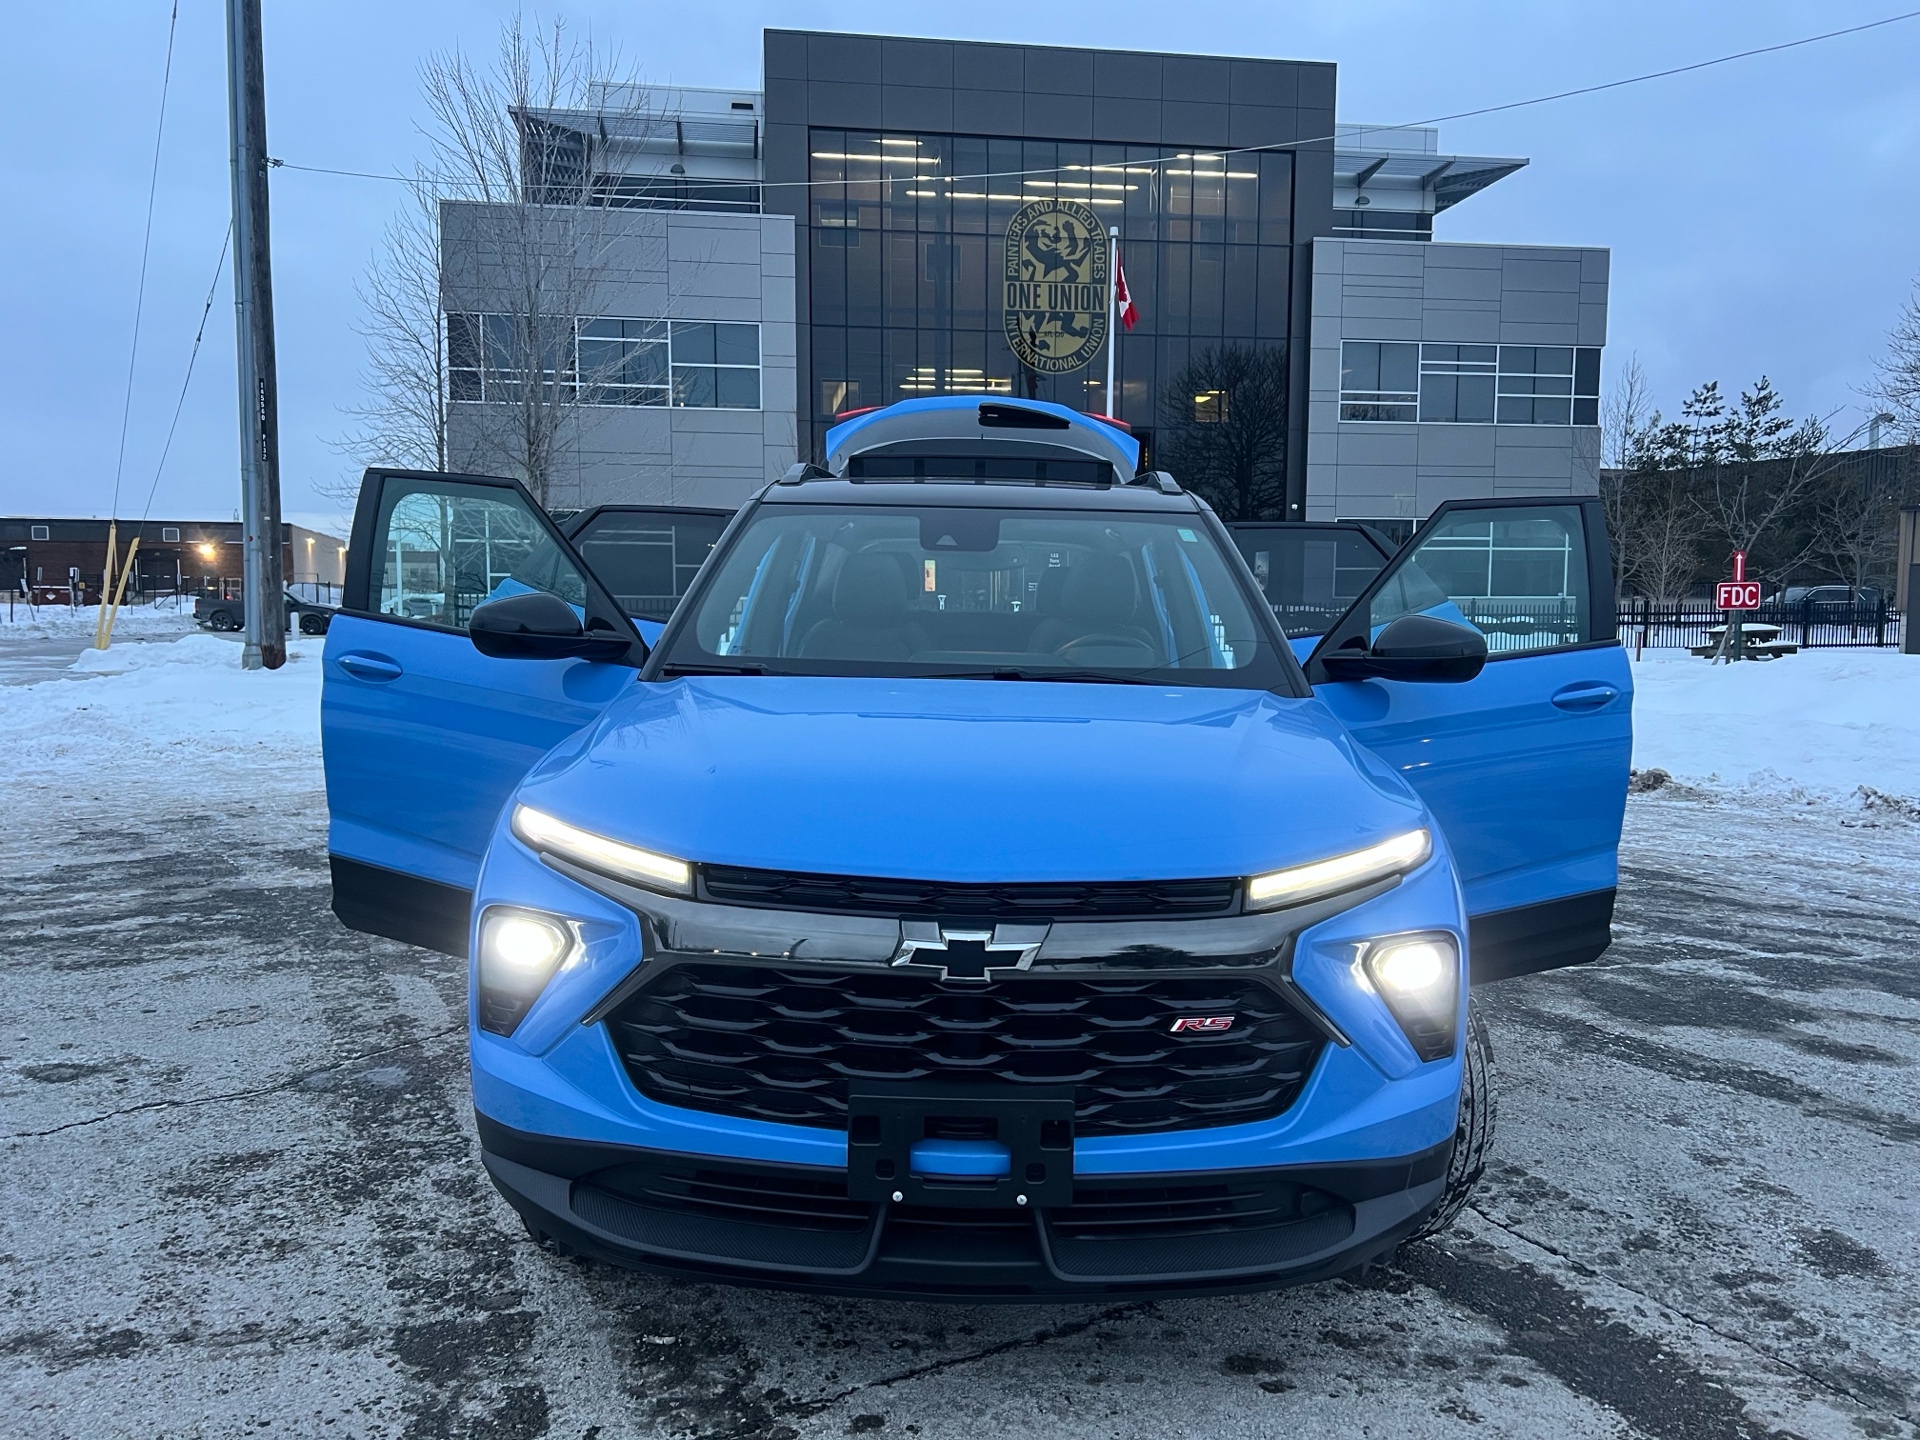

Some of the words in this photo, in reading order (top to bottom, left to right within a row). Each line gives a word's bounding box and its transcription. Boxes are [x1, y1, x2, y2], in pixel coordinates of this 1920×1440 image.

[1007, 216, 1028, 276] PAINTERS
[1027, 200, 1053, 220] AND
[1056, 201, 1096, 229] ALLIED
[1091, 227, 1105, 279] TRADES
[1007, 283, 1041, 309] ONE
[1048, 284, 1105, 311] UNION
[1006, 315, 1082, 371] INTERNATIONAL
[1080, 318, 1104, 358] UNION
[1720, 586, 1757, 606] FDC
[1170, 1016, 1235, 1032] RS
